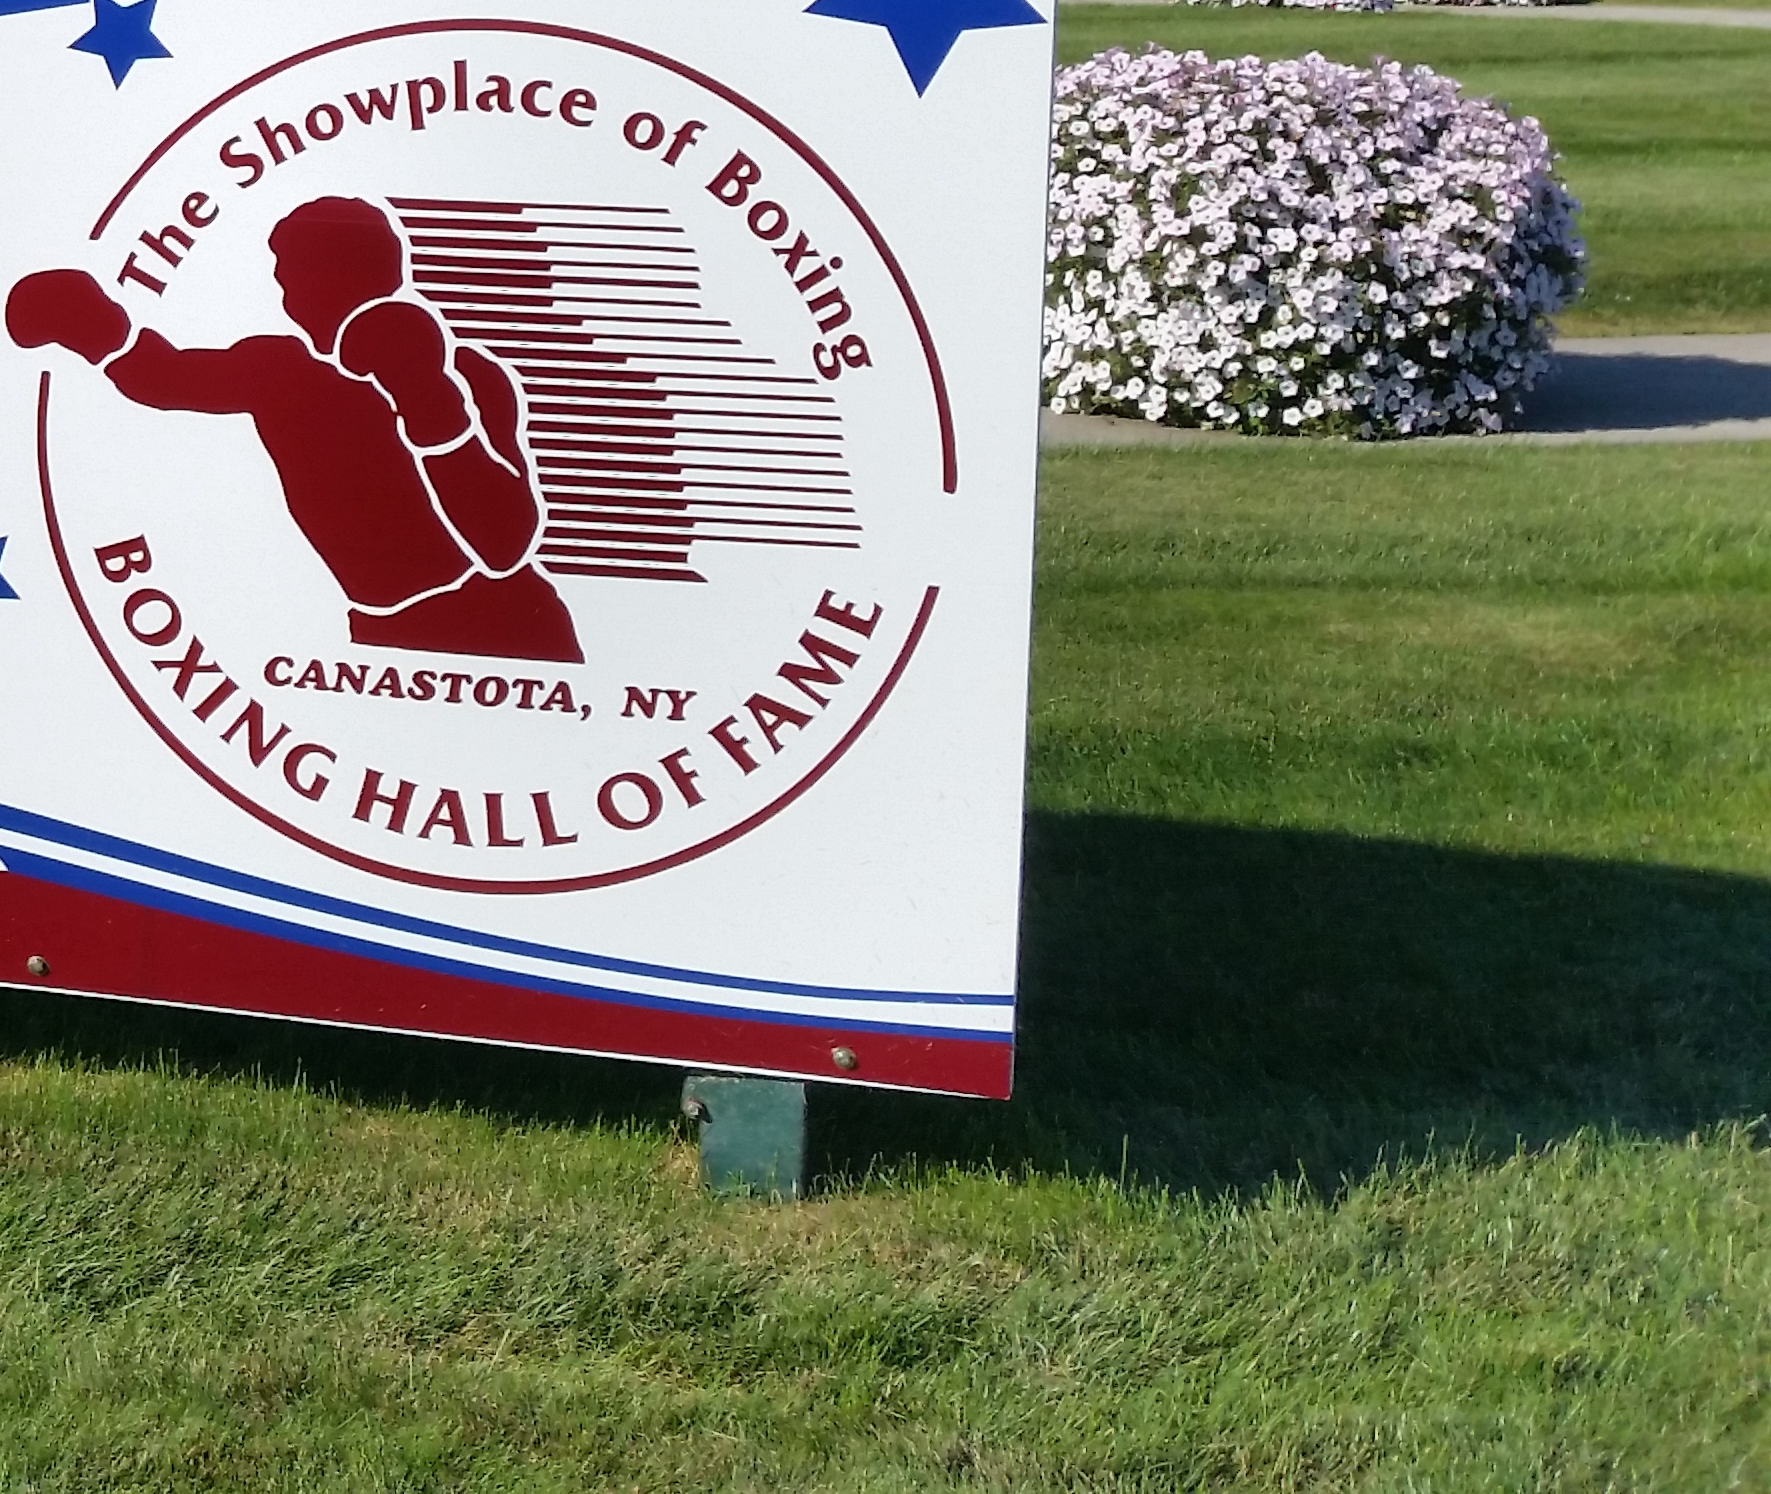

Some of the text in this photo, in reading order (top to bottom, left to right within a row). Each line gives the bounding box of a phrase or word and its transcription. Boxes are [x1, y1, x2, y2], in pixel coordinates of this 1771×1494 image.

[117, 60, 872, 381] The Showplace of Boxing
[93, 535, 883, 848] BOXING HALL OF FAME
[263, 655, 699, 722] CANASTOTA, NY
